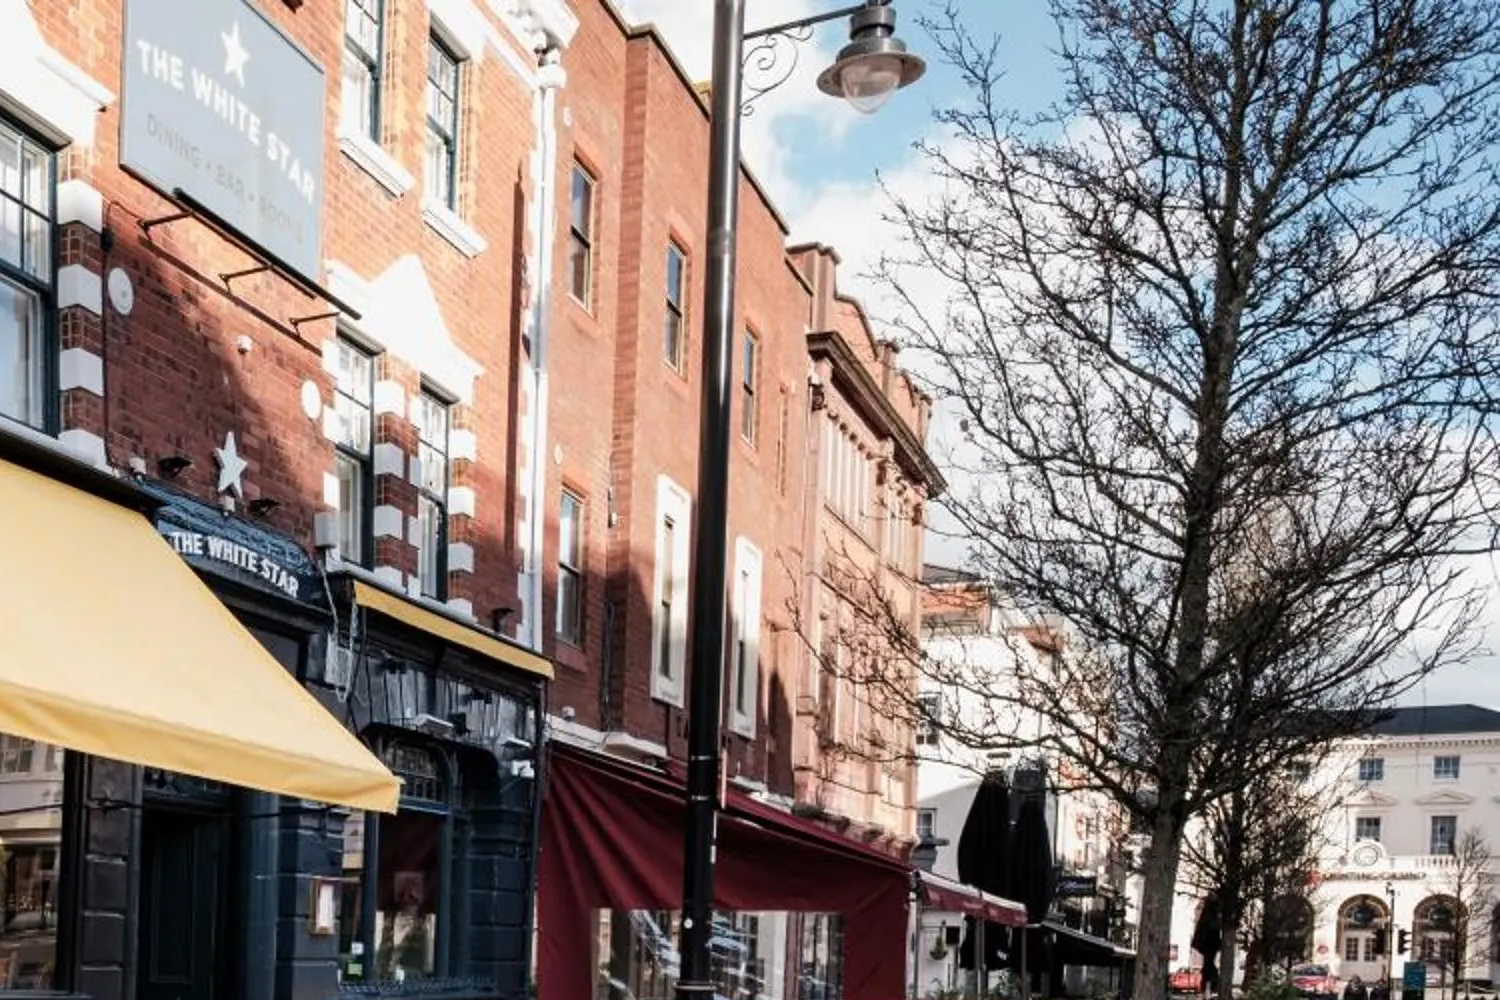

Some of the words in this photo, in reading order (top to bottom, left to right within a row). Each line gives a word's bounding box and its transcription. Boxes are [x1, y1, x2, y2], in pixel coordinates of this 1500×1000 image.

[136, 39, 184, 91] THE
[190, 67, 261, 147] WHITE
[267, 131, 316, 205] STAR
[169, 530, 204, 555] THE
[207, 535, 260, 574] WHITE
[260, 555, 300, 599] STAR
